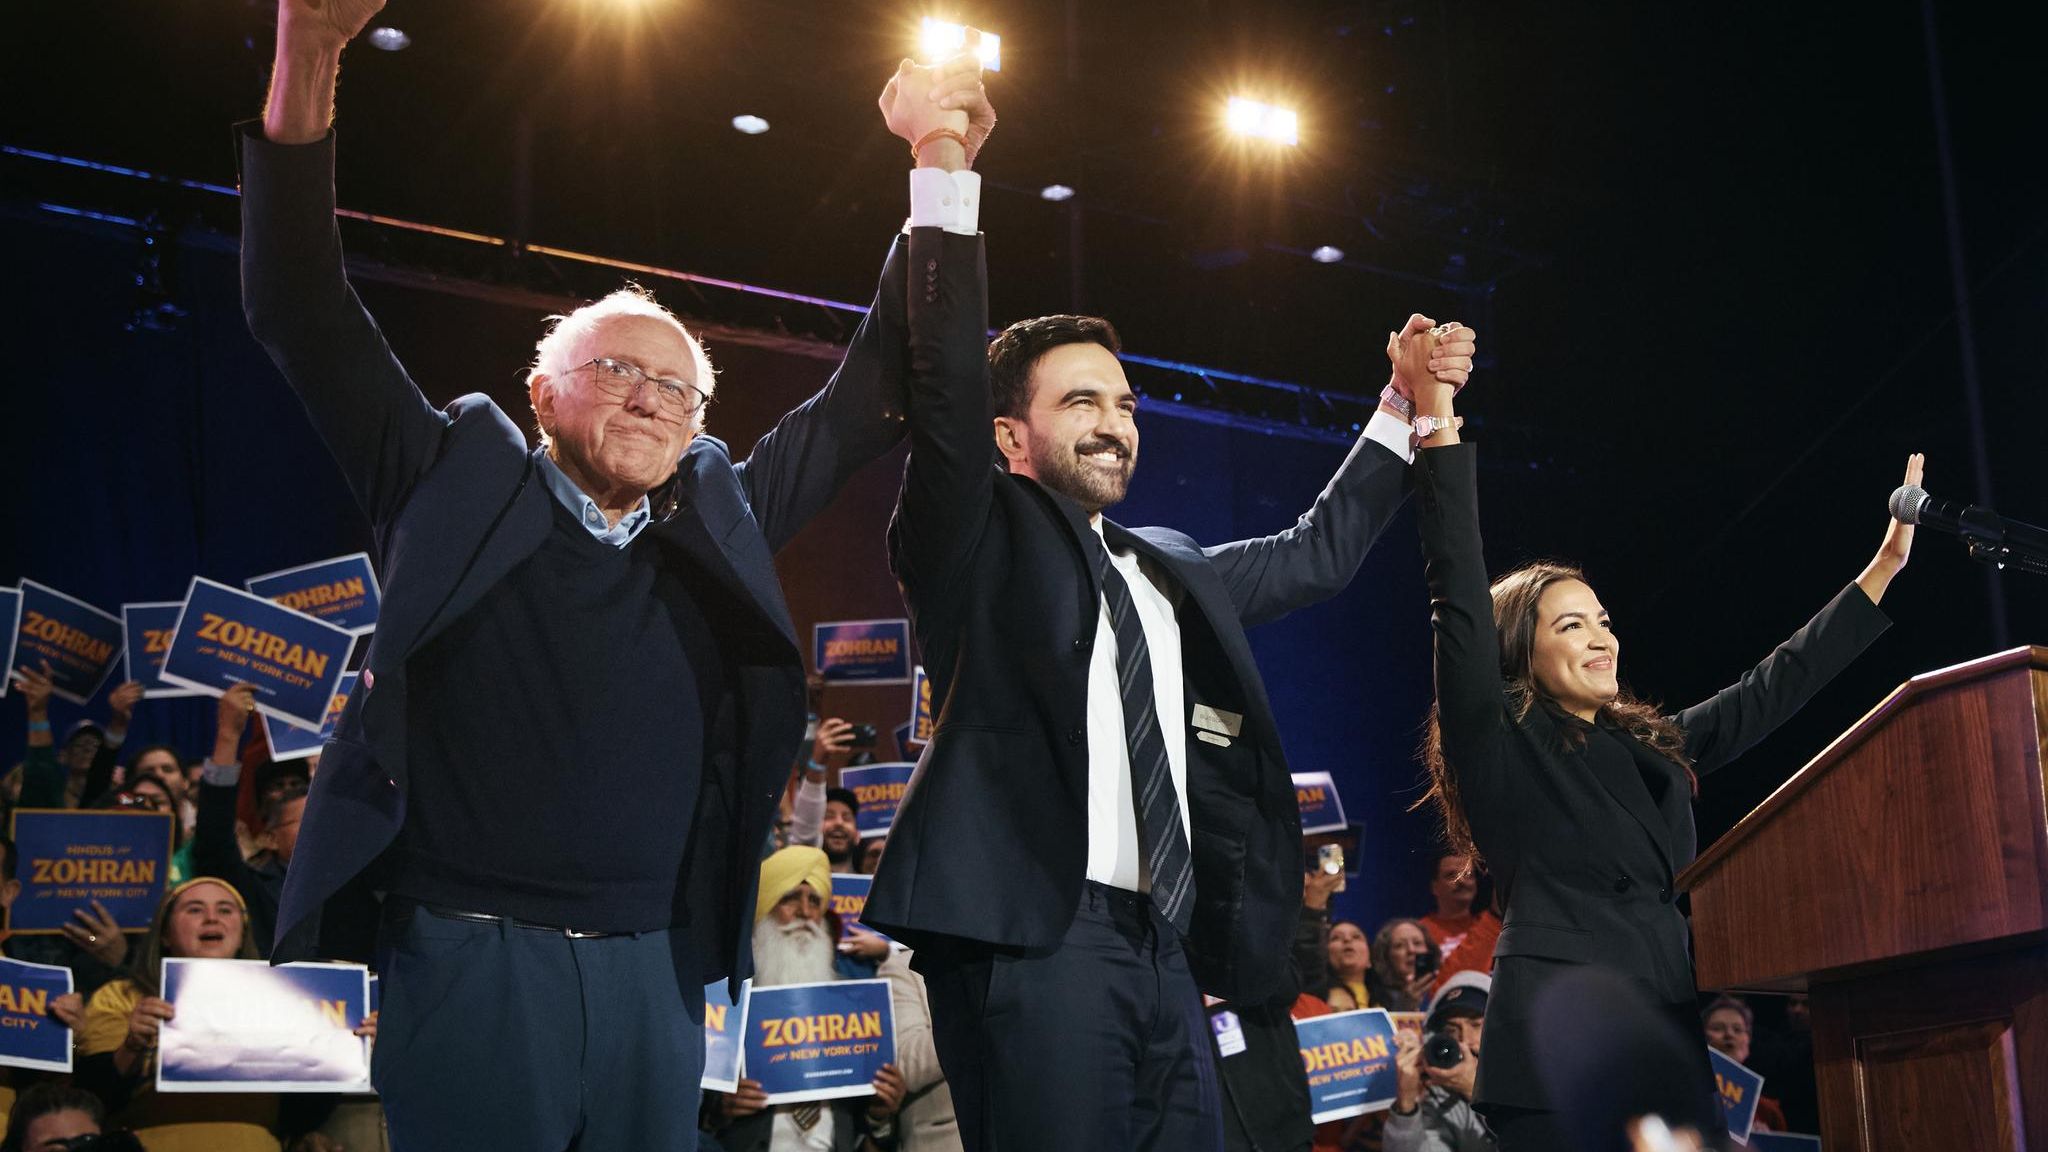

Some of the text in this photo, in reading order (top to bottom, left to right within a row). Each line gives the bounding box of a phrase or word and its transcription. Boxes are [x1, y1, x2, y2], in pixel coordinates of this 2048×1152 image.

[275, 576, 365, 610] OHRAN
[22, 611, 113, 663] ZOHRAN
[197, 612, 329, 678] ZOHRAN
[825, 638, 897, 657] ZOHRAN
[218, 649, 249, 666] NEW
[252, 661, 283, 679] YORK
[284, 673, 313, 688] CITY
[31, 858, 156, 883] ZOHRAN
[57, 888, 88, 898] NEW
[91, 888, 122, 897] YORK
[1, 1017, 38, 1030] CITY
[761, 1011, 882, 1046] ZOHRAN
[790, 1049, 820, 1059] NEW
[823, 1046, 851, 1056] YORK
[853, 1043, 879, 1054] CITY
[1334, 1068, 1361, 1081] YORK
[1364, 1062, 1388, 1074] CITY
